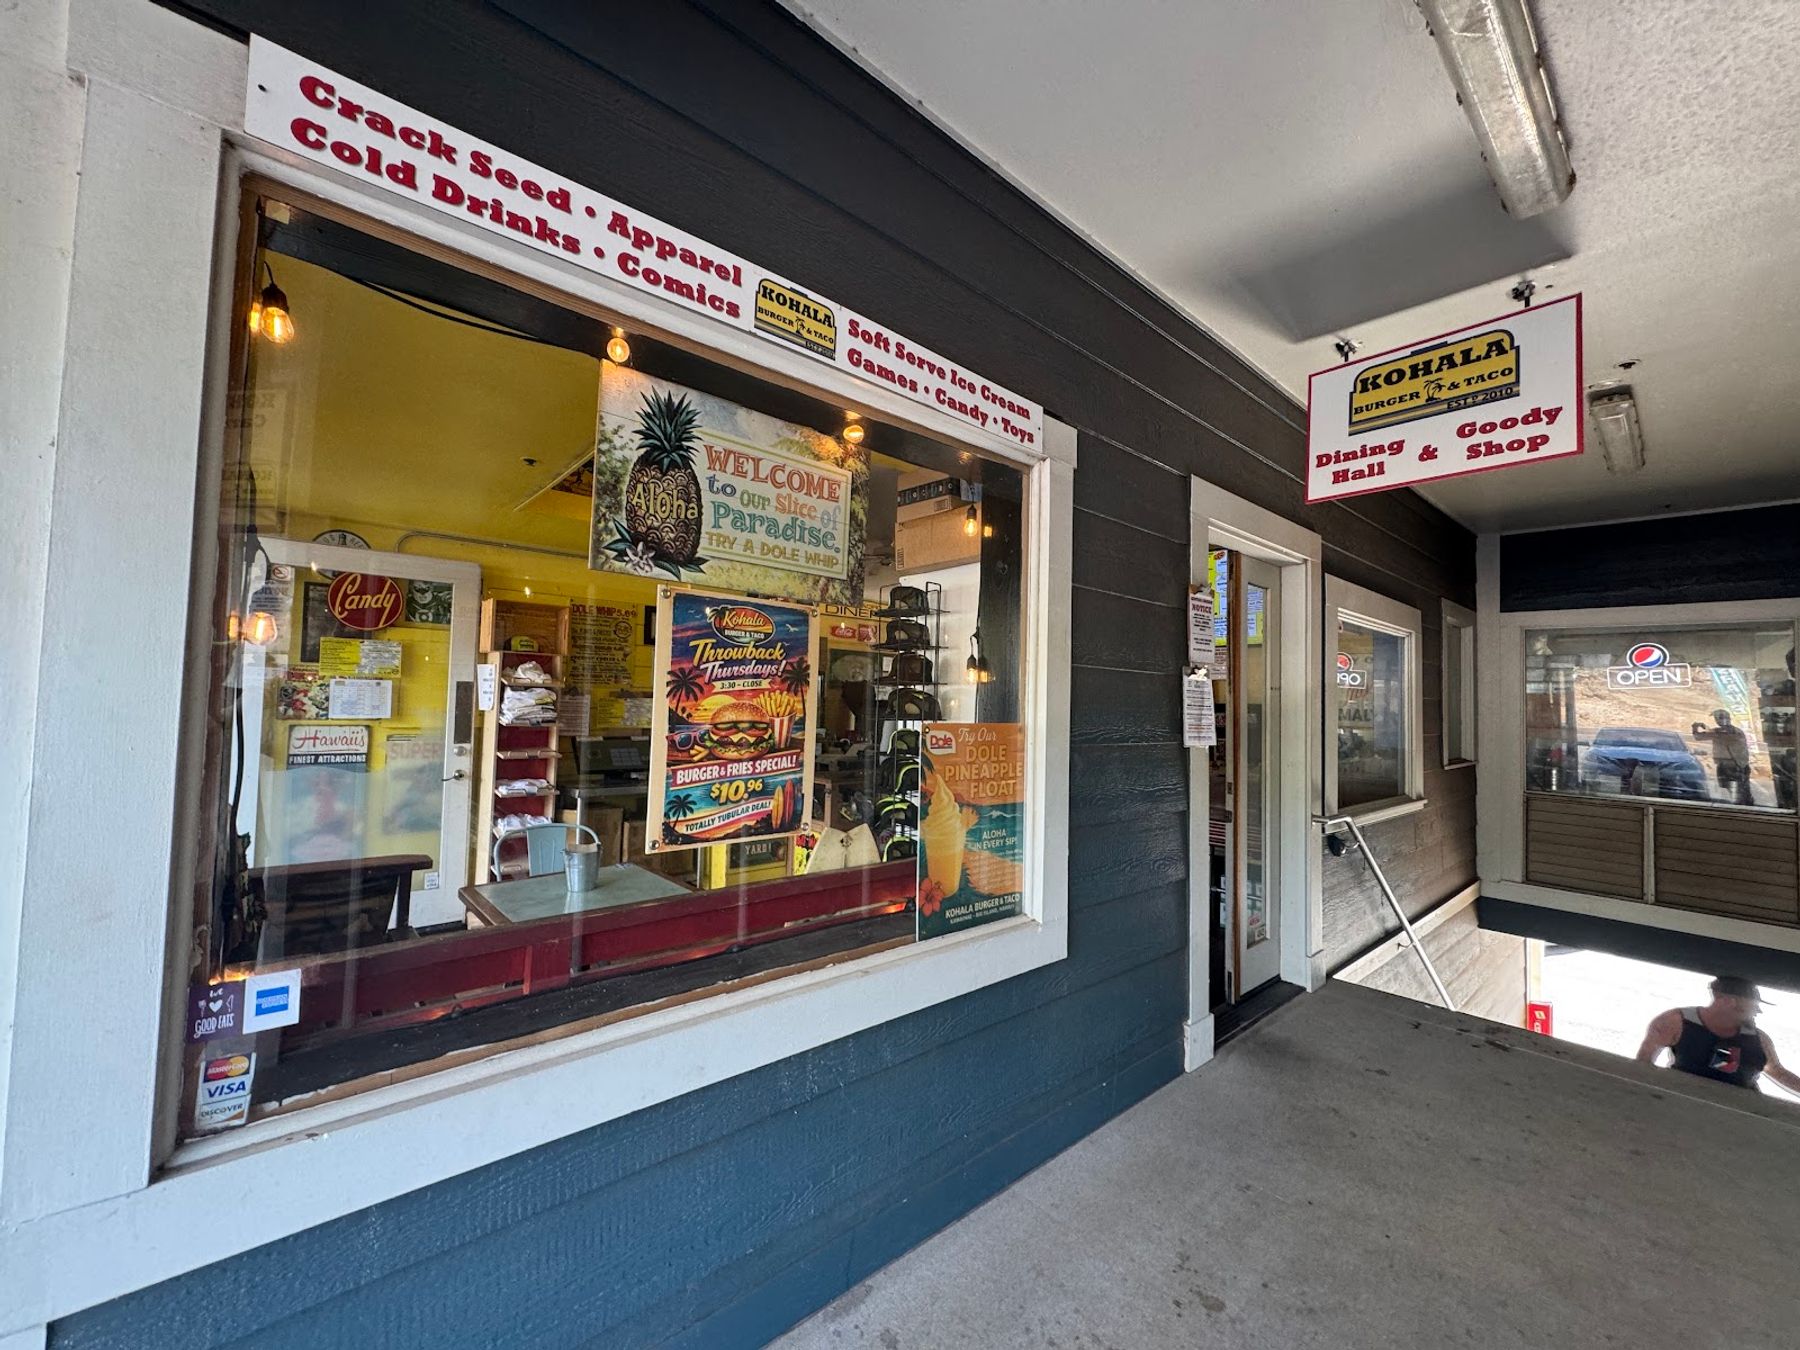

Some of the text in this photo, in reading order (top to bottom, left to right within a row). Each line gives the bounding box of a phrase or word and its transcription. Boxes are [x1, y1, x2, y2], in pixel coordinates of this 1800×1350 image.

[299, 75, 742, 287] Crack Seed Apparel
[290, 117, 741, 318] Cold Drinks Comics
[761, 285, 833, 328] KOHALA
[758, 306, 795, 327] BURGER
[813, 330, 834, 344] TACO
[848, 319, 1031, 420] Soft Serve Ice Cream
[1359, 338, 1509, 394] KOHALA
[848, 348, 1035, 445] Games Candy Toys
[1354, 366, 1514, 415] BURGER & TACO
[1481, 387, 1514, 403] 2010
[1456, 406, 1563, 438] Goody
[1316, 439, 1405, 468] Dining
[1418, 445, 1438, 462] &
[1466, 433, 1550, 460] Shop
[704, 444, 842, 503] WELCOME
[1332, 461, 1385, 484] Hall
[631, 483, 698, 521] Aloha
[706, 474, 737, 498] to
[820, 505, 842, 531] of
[711, 501, 841, 553] Paradise.
[706, 531, 839, 569] TRY A DOLE WHIP
[336, 573, 397, 628] Candy
[723, 610, 765, 627] Kohala
[689, 638, 786, 667] Throwback
[700, 660, 786, 684] Thursdays!
[720, 682, 736, 690] 3:30
[742, 680, 763, 688] CLOSE
[1616, 668, 1681, 685] OPEN
[292, 728, 365, 749] Hawaii's
[930, 735, 953, 747] Dole
[958, 727, 997, 744] Try Our
[289, 754, 367, 764] FINEST ATTRACTIONS
[966, 745, 1008, 762] DOLE
[676, 755, 797, 784] BURGER & FRIES SPECIAL!
[945, 762, 1023, 781] PINEAPPLE
[970, 780, 1016, 798] FLOAT
[685, 801, 771, 833] TOTALLY TUBULAR DEAL!
[982, 828, 1007, 839] ALOHA
[983, 839, 1004, 850] EVERY
[945, 905, 973, 918] KOHALA
[974, 898, 999, 912] BURGER
[1004, 893, 1020, 904] TACO
[194, 1013, 235, 1039] GOOD EATS
[207, 1081, 247, 1098] VISA
[201, 1103, 244, 1118] DISCOVER
